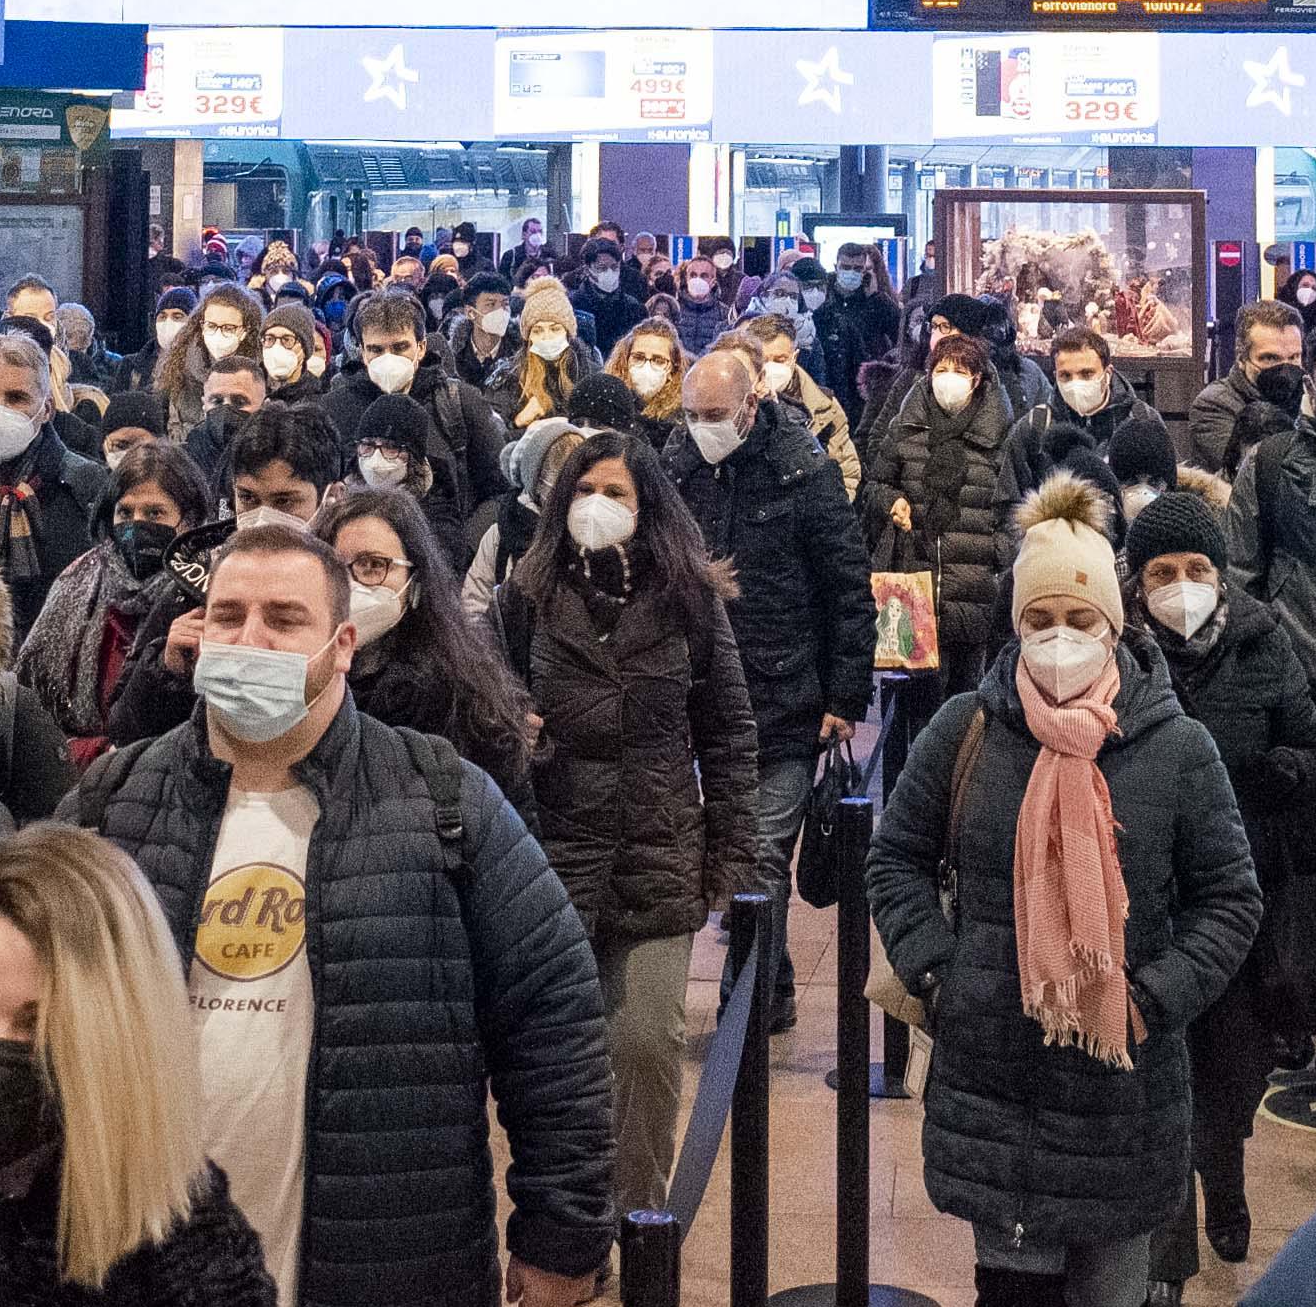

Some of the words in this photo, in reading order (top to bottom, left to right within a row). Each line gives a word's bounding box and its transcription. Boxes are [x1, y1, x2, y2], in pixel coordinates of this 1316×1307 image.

[630, 78, 685, 93] 499€
[196, 94, 263, 114] 329€
[1065, 100, 1138, 121] 329€
[226, 125, 279, 137] euronics
[657, 127, 710, 141] euronics
[1101, 130, 1155, 144] euronics
[199, 886, 256, 927] rd
[255, 886, 305, 933] Ro
[221, 942, 275, 959] CAFE
